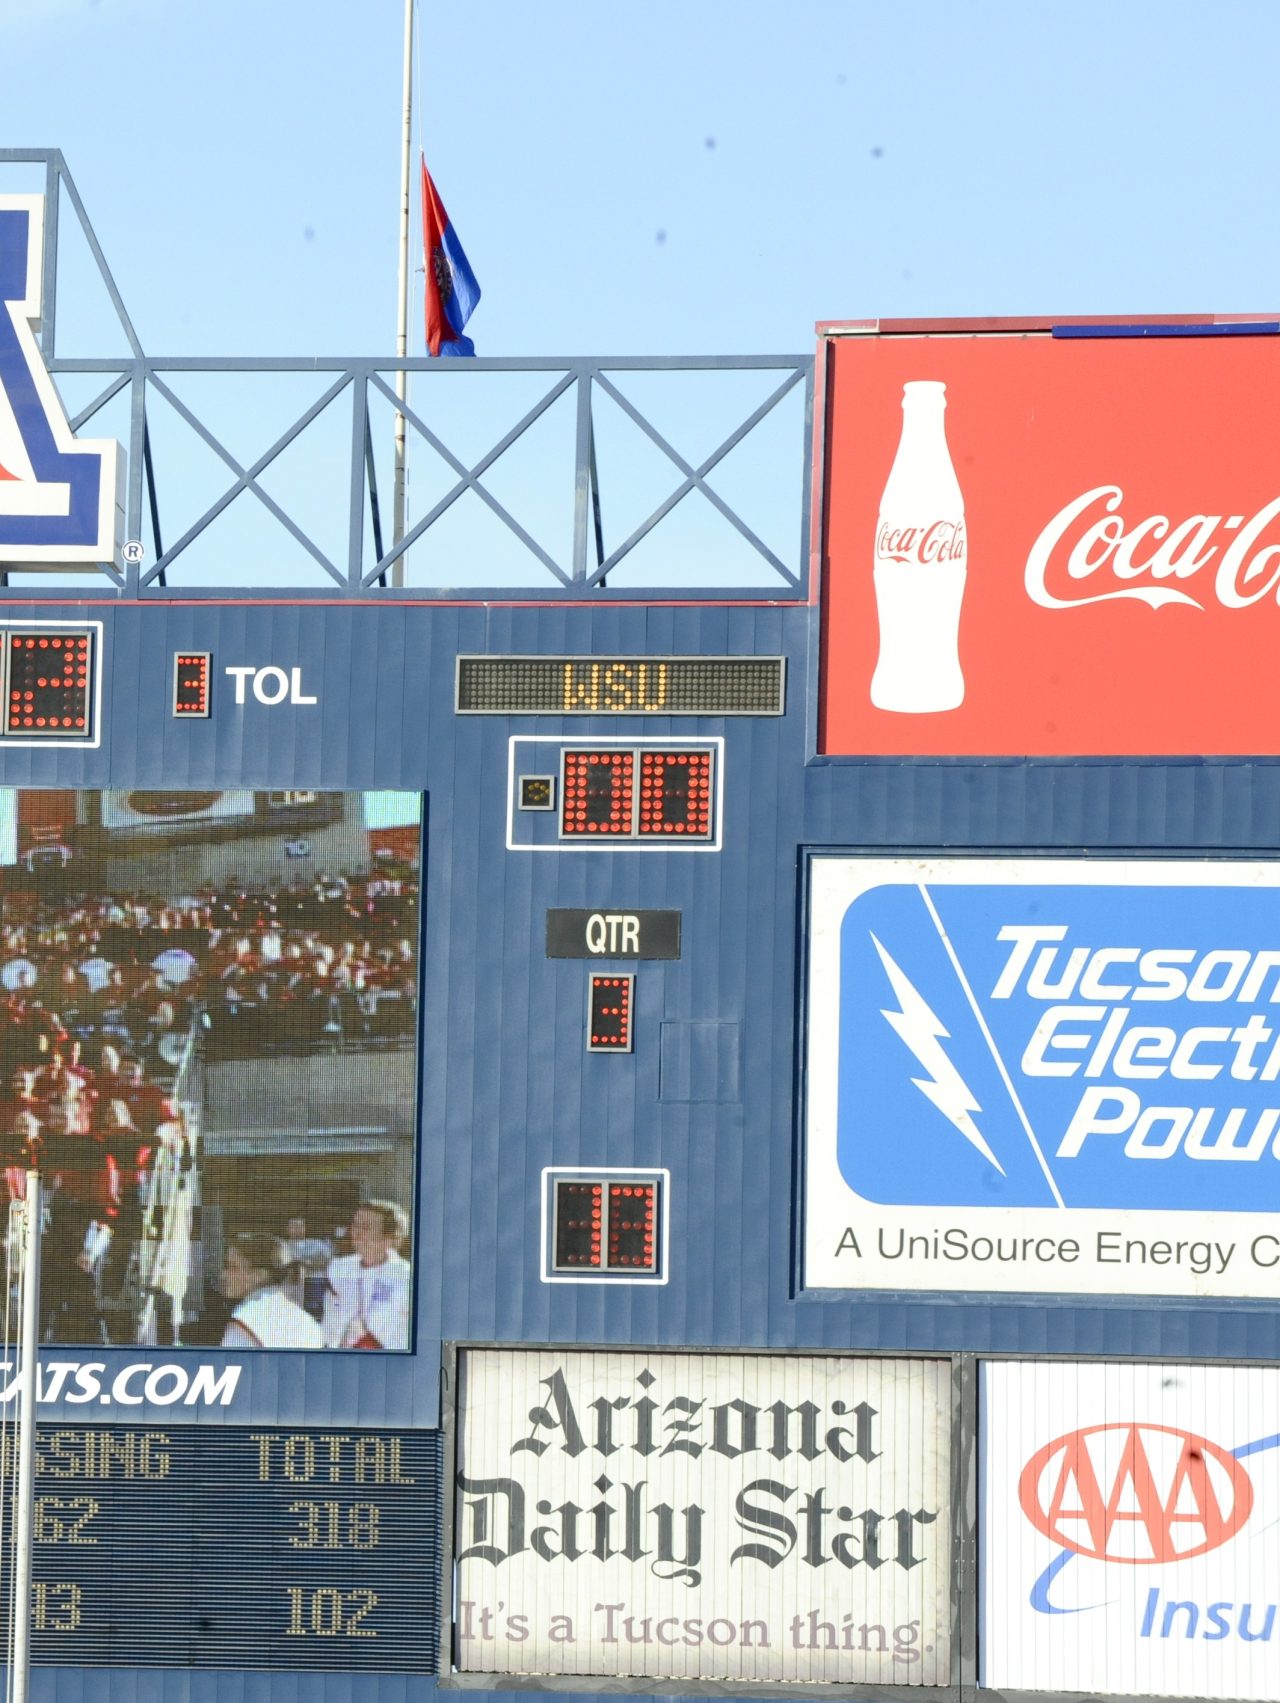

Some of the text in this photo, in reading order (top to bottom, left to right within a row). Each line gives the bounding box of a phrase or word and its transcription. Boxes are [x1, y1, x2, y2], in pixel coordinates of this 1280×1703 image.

[876, 520, 966, 565] Coca-Cola
[177, 657, 207, 711] 3
[225, 666, 317, 705] TOL
[564, 663, 667, 710] WSU
[564, 754, 711, 832] 00
[585, 914, 640, 953] QTR
[591, 979, 629, 1043] 3
[1055, 1086, 1280, 1161] Pow
[834, 1227, 862, 1258] A
[878, 1227, 1080, 1262] UniSource
[1096, 1231, 1236, 1274] Energy
[510, 1367, 883, 1463] Arizona
[250, 1435, 417, 1484] TOTAL
[288, 1501, 380, 1549] 318
[457, 1470, 939, 1588] Daily Star
[286, 1588, 378, 1636] 102
[548, 1614, 575, 1643] a
[594, 1602, 770, 1648] Tucson
[790, 1609, 934, 1665] thing.
[1140, 1587, 1277, 1642] Insu
